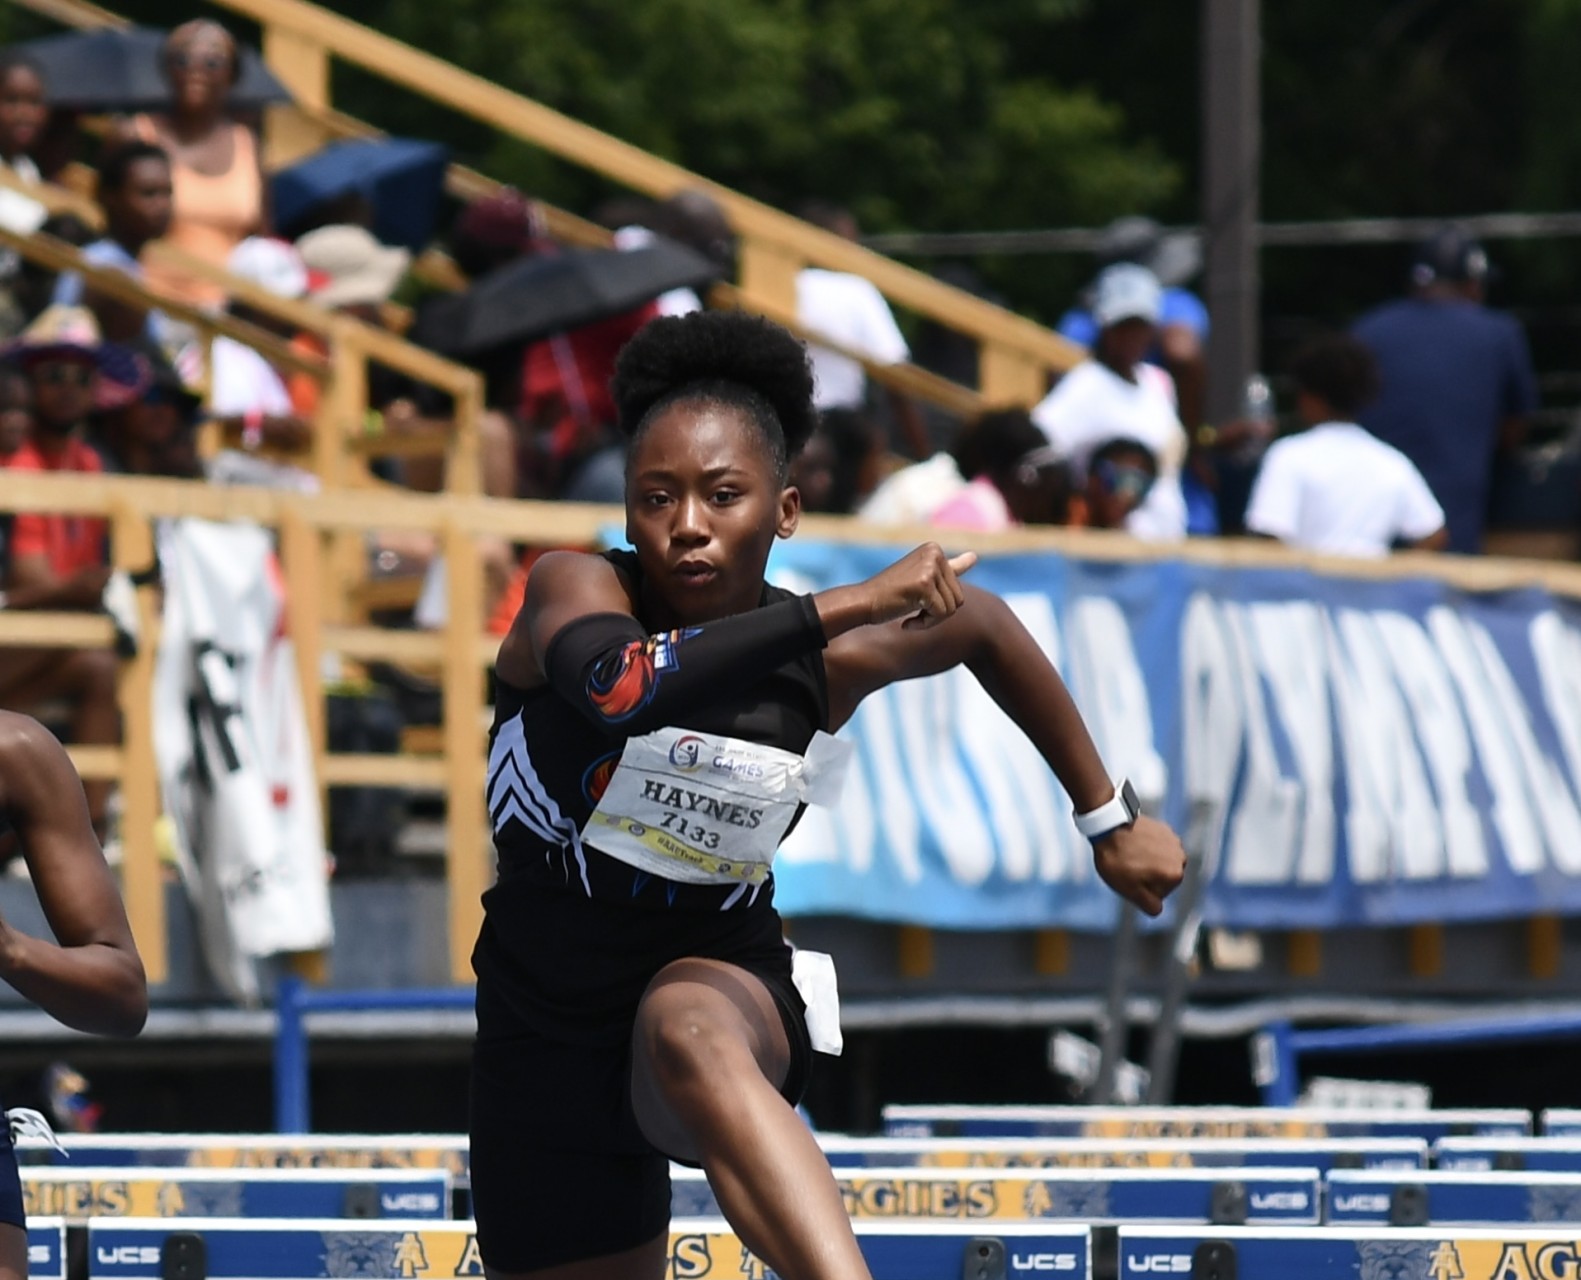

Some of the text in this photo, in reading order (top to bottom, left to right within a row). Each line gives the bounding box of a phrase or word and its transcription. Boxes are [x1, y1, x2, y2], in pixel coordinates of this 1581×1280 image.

[712, 755, 764, 778] GAMES
[639, 779, 764, 829] HAYNES
[659, 811, 722, 849] 7133
[381, 1192, 440, 1211] UCS
[1250, 1192, 1308, 1211] UCS
[1334, 1194, 1391, 1213] UCS
[96, 1246, 161, 1264] UCS
[1012, 1253, 1077, 1271] UCS
[1127, 1254, 1193, 1273] UCS
